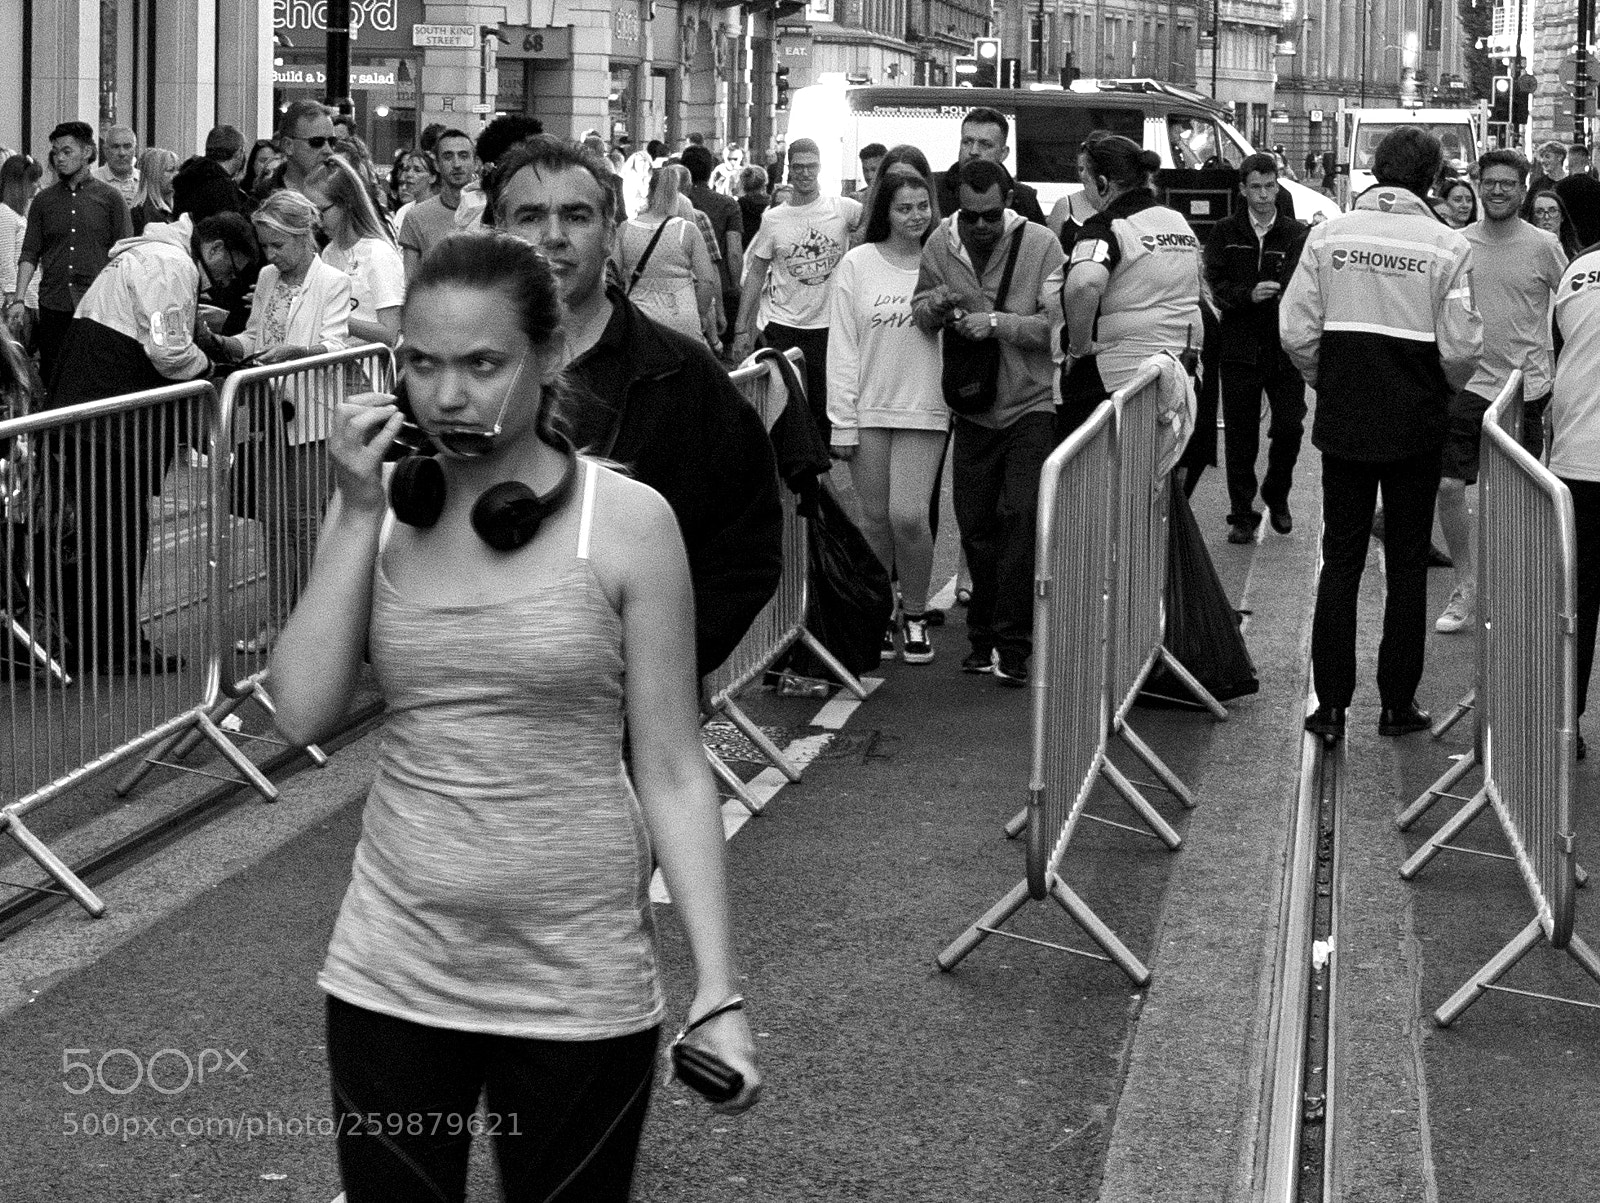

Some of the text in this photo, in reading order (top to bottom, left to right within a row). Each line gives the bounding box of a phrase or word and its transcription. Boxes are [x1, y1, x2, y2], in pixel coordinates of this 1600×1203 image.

[415, 26, 473, 36] SOUTH KING
[427, 36, 460, 45] STREET
[305, 72, 315, 83] a
[358, 72, 395, 85] salad
[941, 105, 977, 115] POLI
[1156, 233, 1197, 248] SHOWSE
[1349, 250, 1427, 274] SHOWSEC
